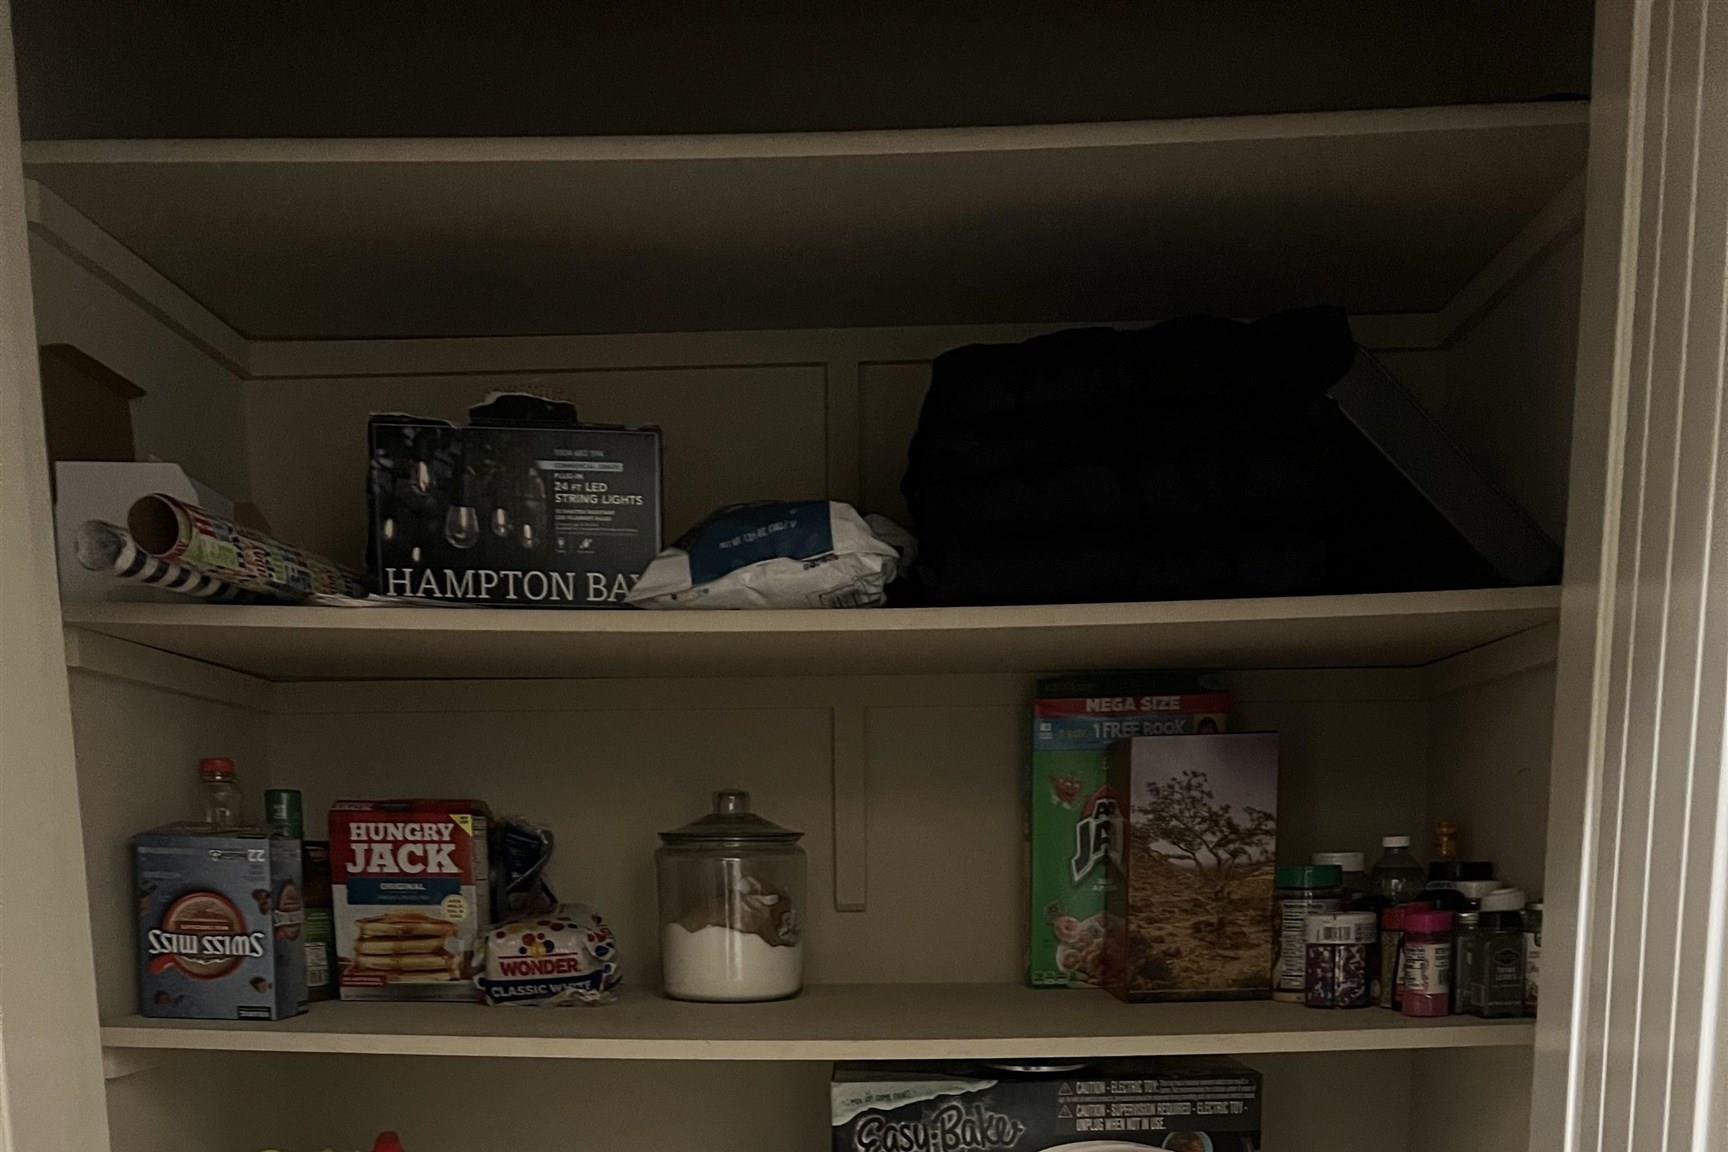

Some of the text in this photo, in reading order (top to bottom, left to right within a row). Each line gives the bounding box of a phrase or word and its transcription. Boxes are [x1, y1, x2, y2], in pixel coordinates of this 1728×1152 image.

[554, 481, 569, 491] 24
[585, 482, 608, 492] LED
[554, 493, 644, 505] STRING LIGHTS
[384, 567, 577, 602] HAMPTON
[1086, 695, 1181, 712] MEGA SIZE
[1102, 721, 1140, 738] FREE
[348, 822, 455, 842] HUNGRY
[345, 842, 464, 874] JACK
[499, 957, 578, 977] WONDER
[491, 984, 547, 998] CLASSIC
